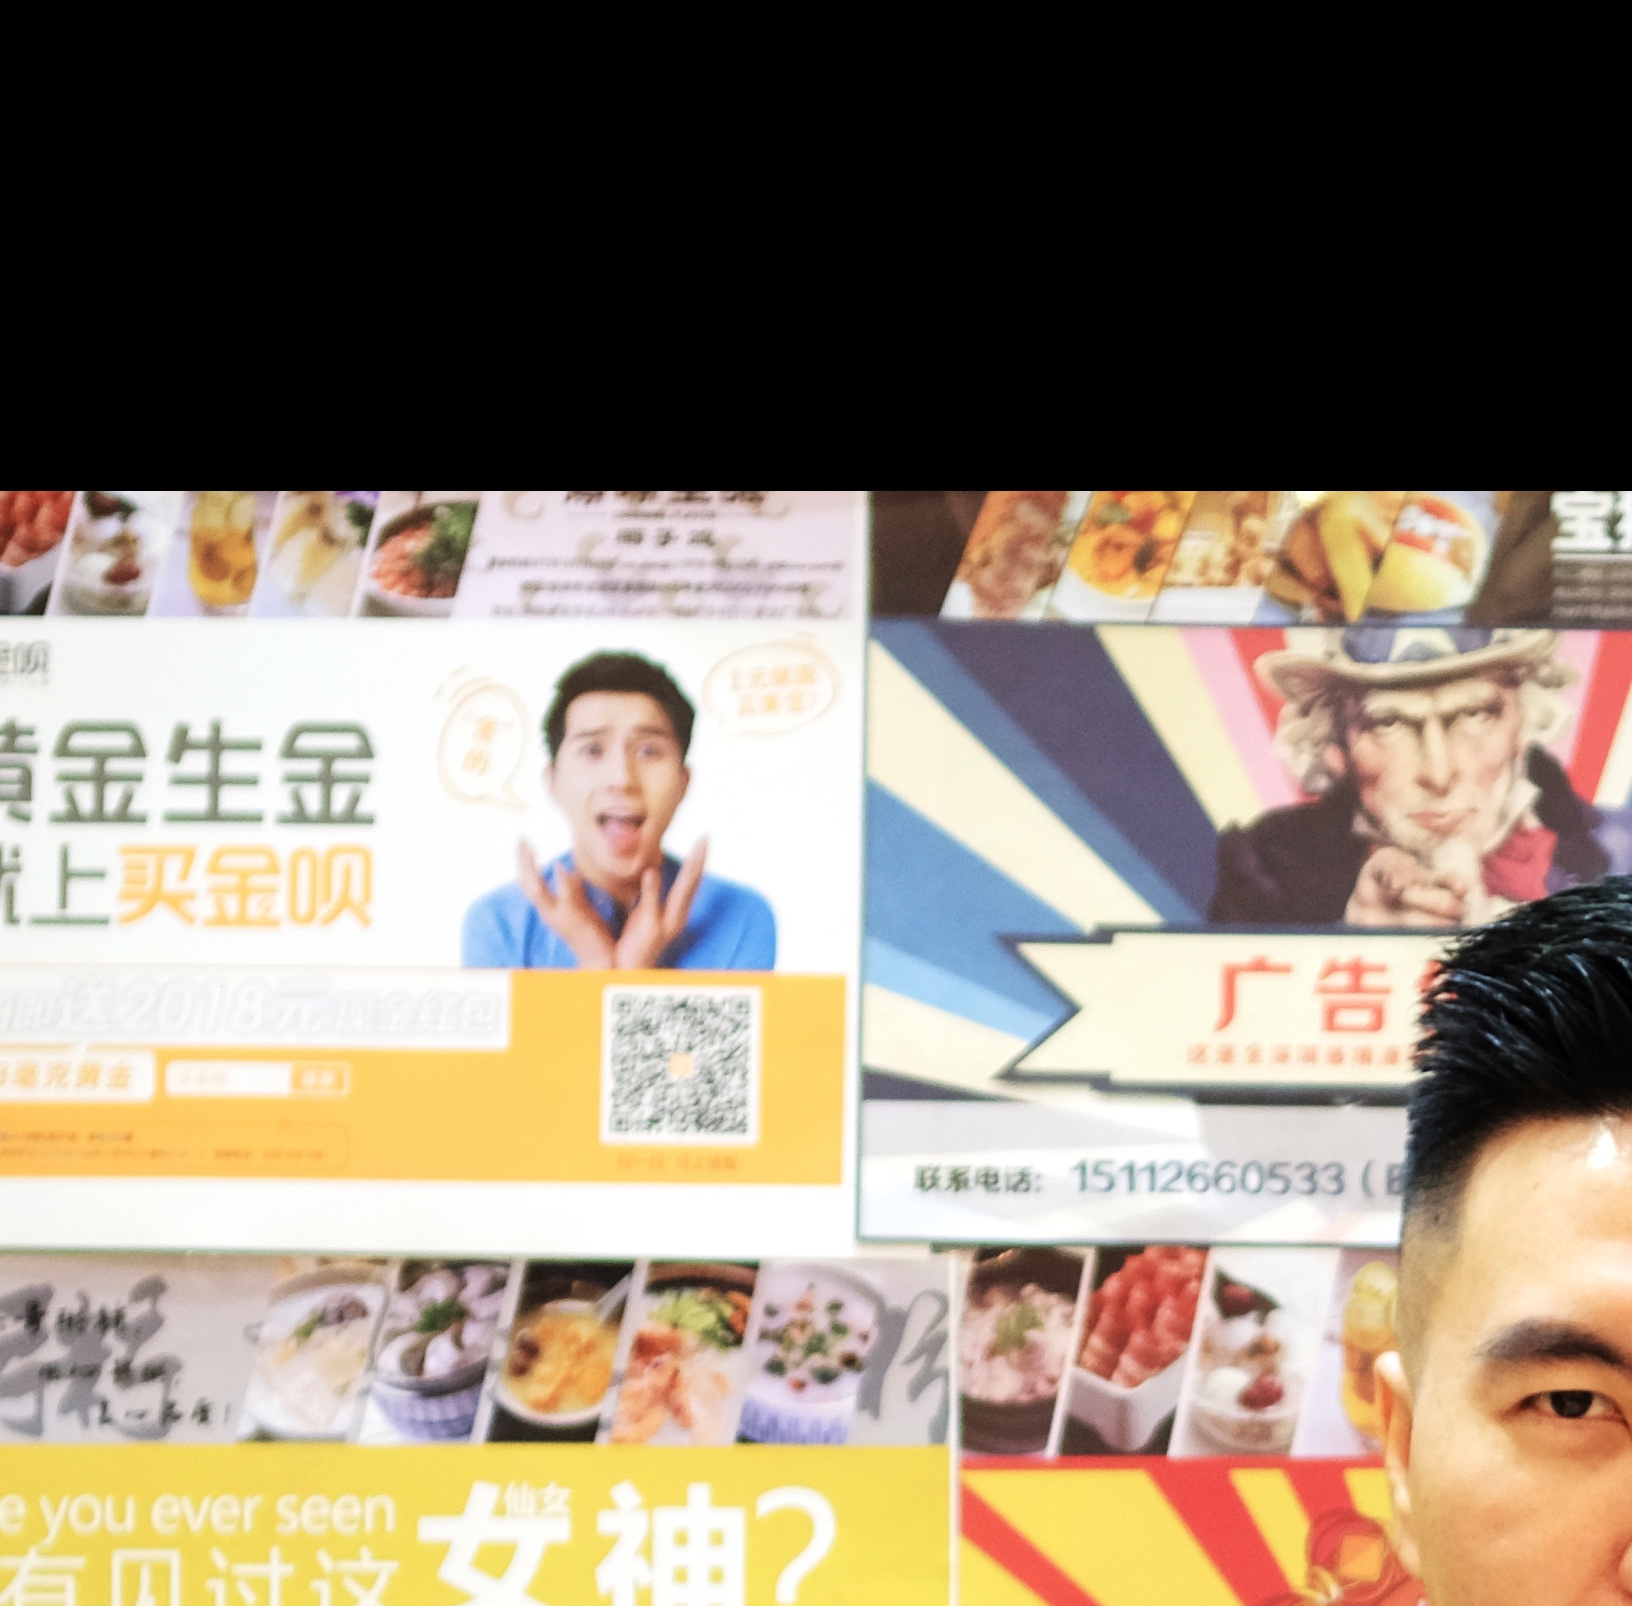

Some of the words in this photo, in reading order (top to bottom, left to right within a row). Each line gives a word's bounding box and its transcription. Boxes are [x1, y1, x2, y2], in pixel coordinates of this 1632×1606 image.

[1213, 955, 1432, 1033] 广告
[1072, 1158, 1345, 1197] 15112660533
[38, 1493, 138, 1548] you
[150, 1491, 262, 1536] ever
[276, 1489, 396, 1536] seen
